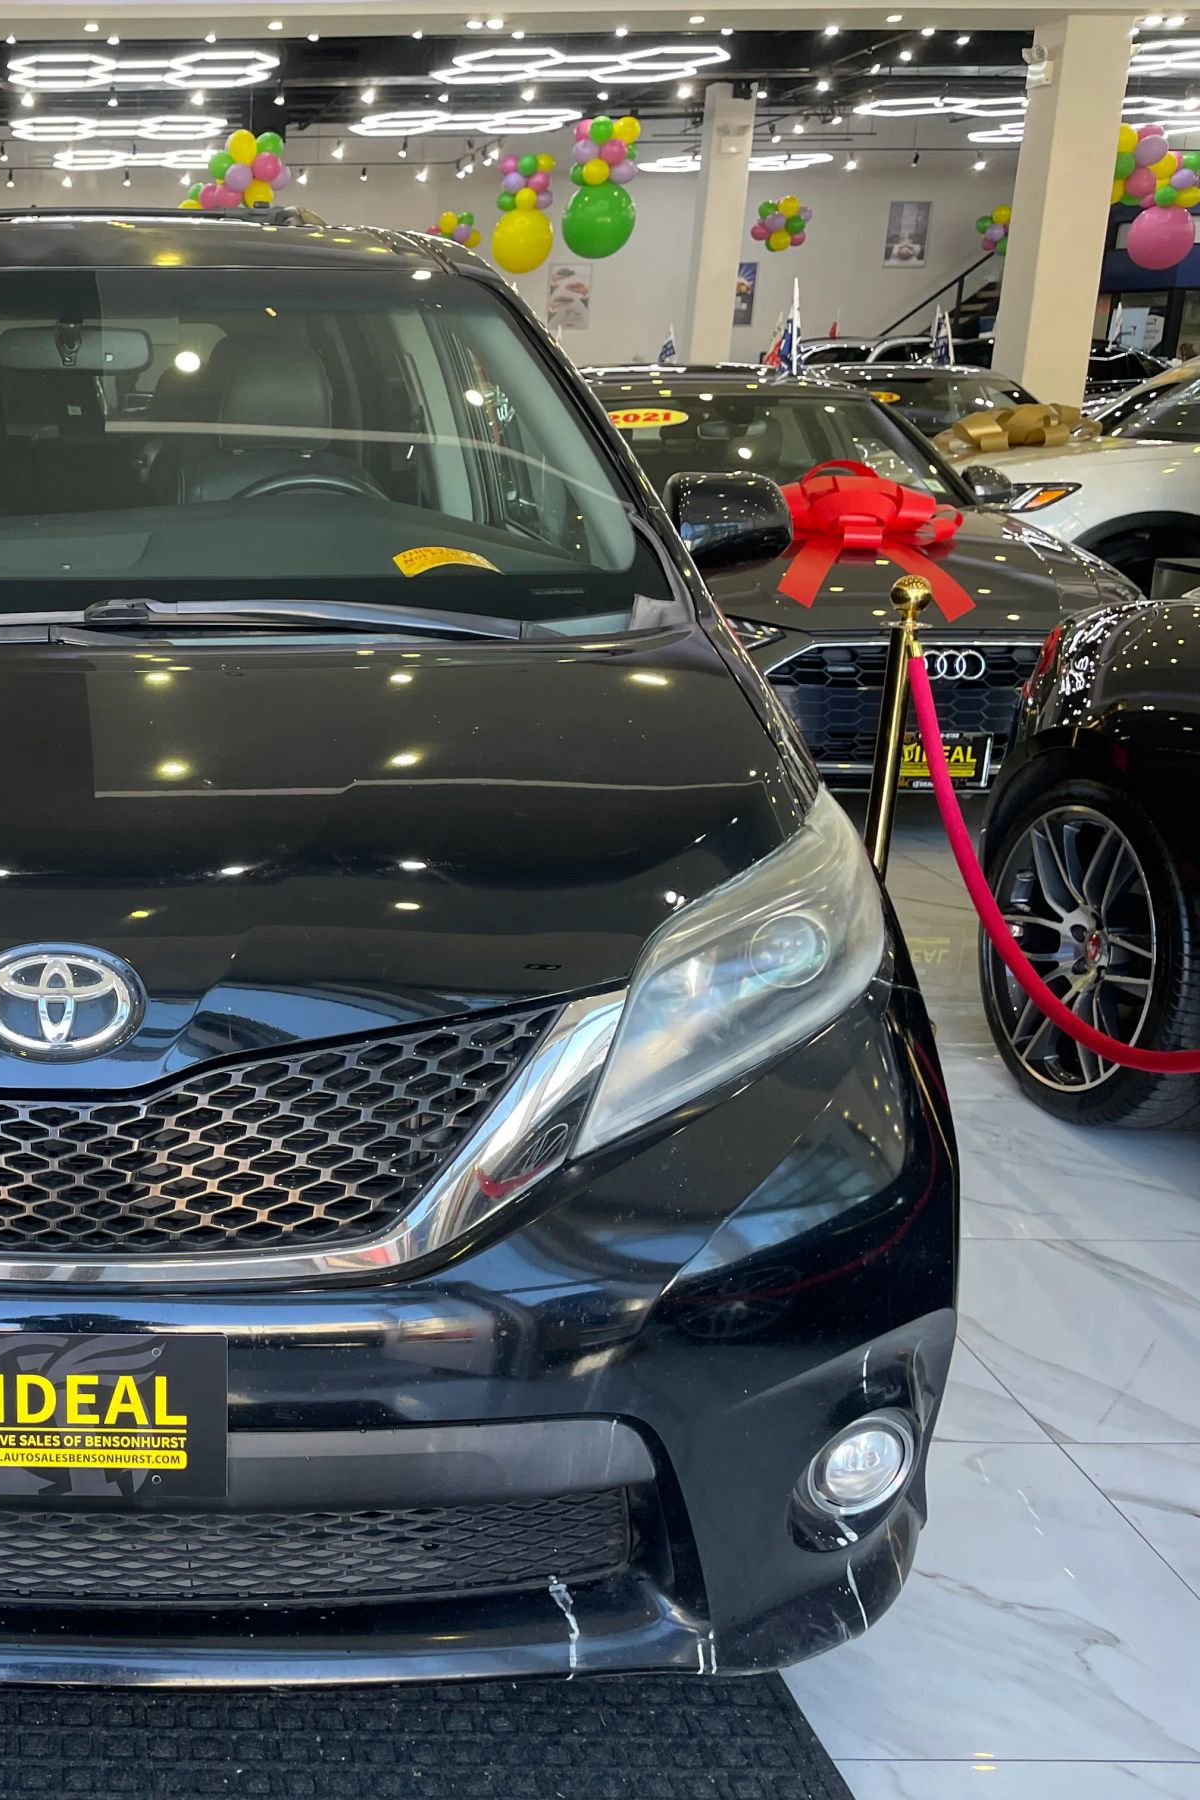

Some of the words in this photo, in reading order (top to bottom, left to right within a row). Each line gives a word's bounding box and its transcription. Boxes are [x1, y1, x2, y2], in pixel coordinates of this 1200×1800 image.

[610, 411, 671, 424] 2021
[19, 1434, 61, 1447] SALES
[63, 1435, 82, 1448] OF
[84, 1435, 187, 1449] BENSONHURST
